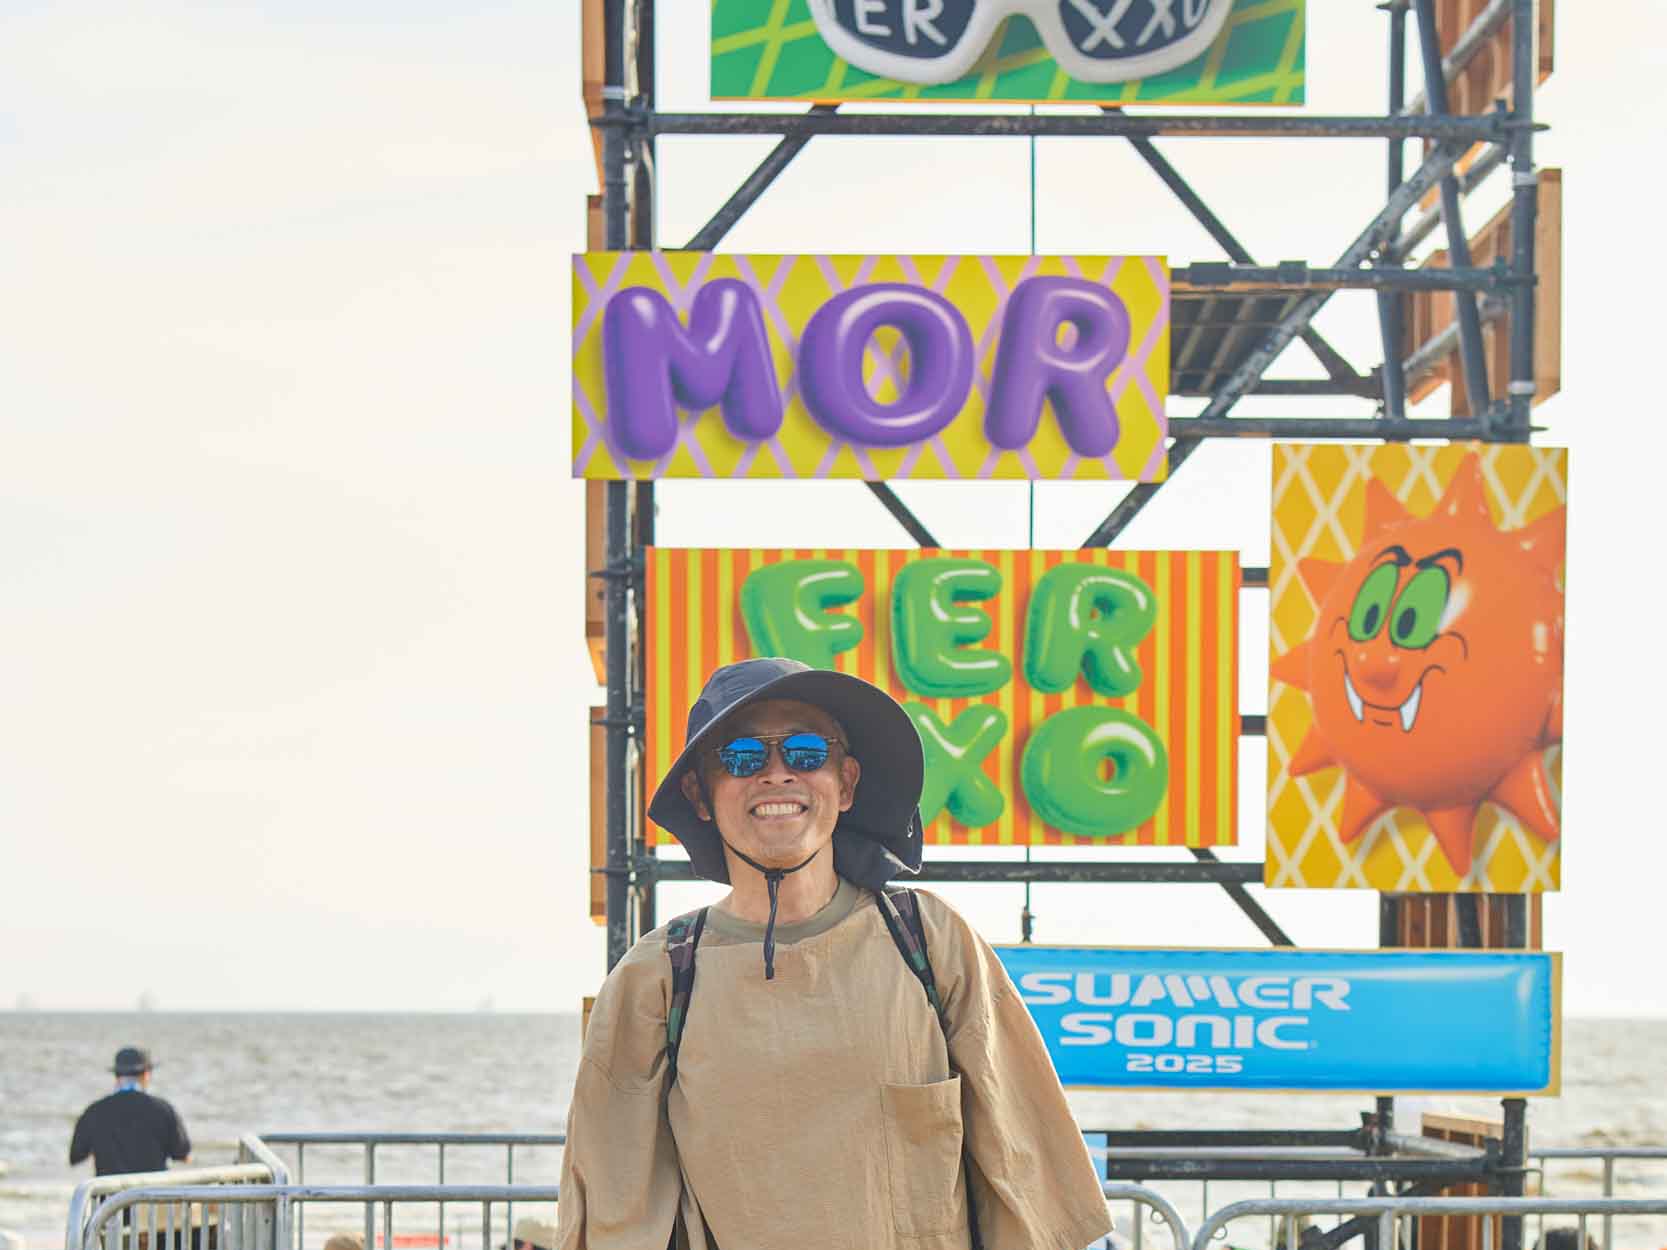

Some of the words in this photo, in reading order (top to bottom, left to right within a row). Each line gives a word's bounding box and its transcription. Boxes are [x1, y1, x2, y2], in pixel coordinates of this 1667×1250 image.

[603, 275, 1131, 461] MOR
[740, 557, 1157, 697] FER
[1020, 971, 1351, 1011] SUMMER
[1059, 1012, 1309, 1050] SONIC
[1126, 1053, 1244, 1073] 2025
